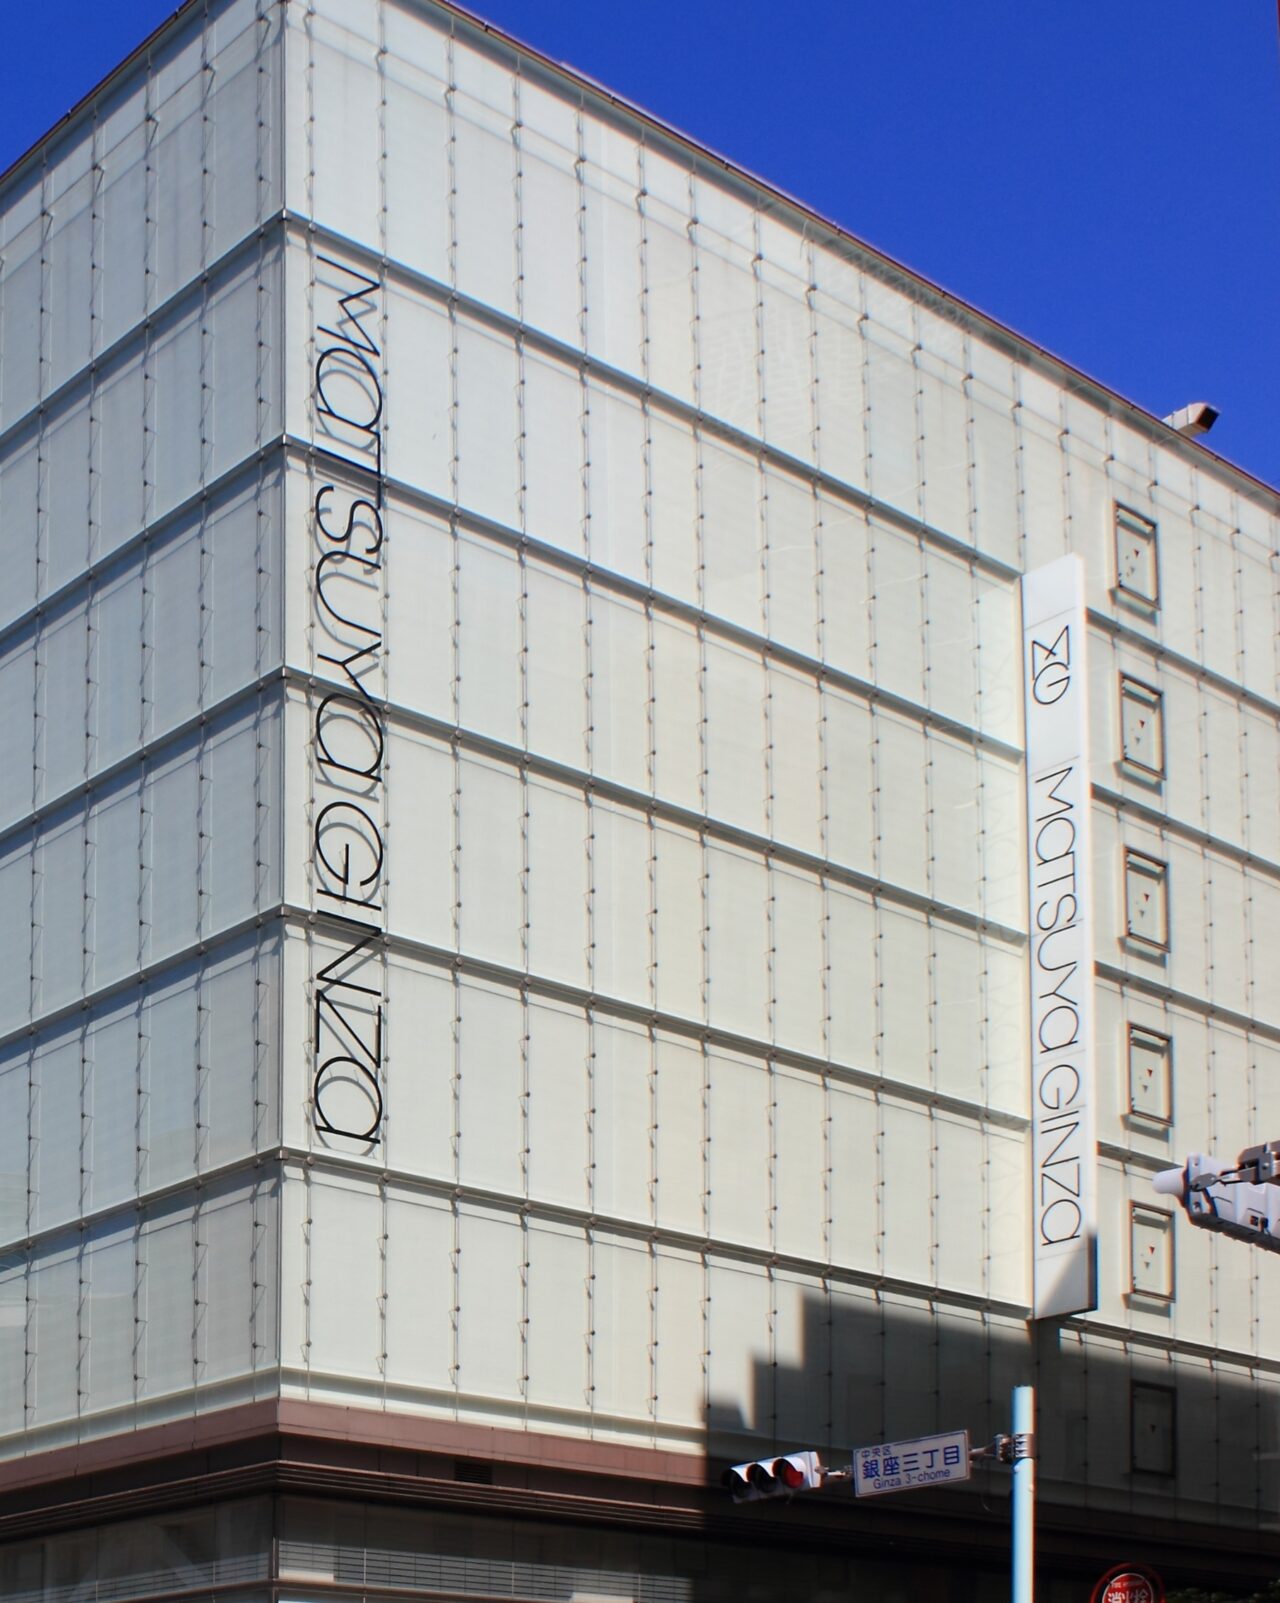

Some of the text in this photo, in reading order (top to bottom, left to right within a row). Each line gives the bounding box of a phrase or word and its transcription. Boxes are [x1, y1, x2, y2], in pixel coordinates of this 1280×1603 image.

[861, 1445, 892, 1458] 中央区
[862, 1445, 960, 1479] 銀座三丁目
[873, 1469, 951, 1489] Ginza 3-chome
